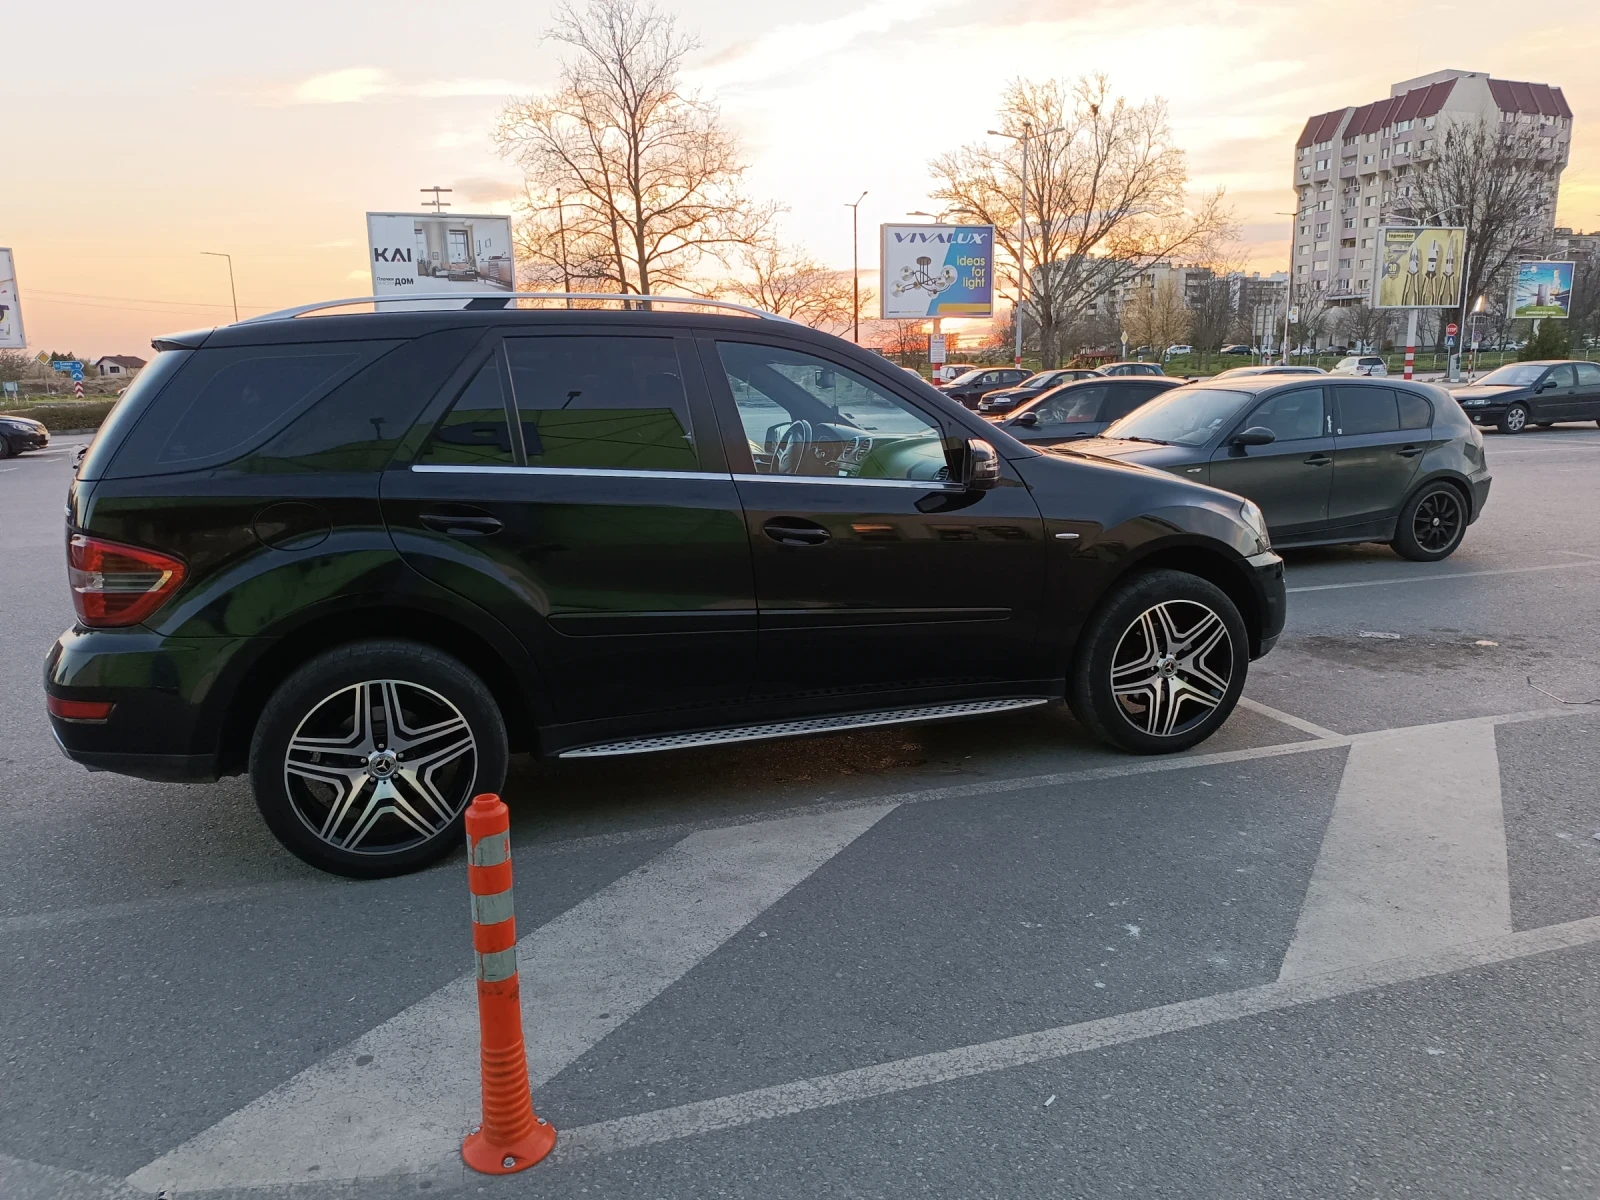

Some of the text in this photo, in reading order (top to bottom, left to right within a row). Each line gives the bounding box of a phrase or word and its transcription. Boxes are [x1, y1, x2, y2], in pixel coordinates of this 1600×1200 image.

[893, 232, 988, 244] VIVALUX
[374, 247, 412, 263] KAI
[956, 255, 986, 266] ideas
[971, 266, 986, 277] for
[1388, 263, 1397, 272] 30
[962, 277, 986, 290] light
